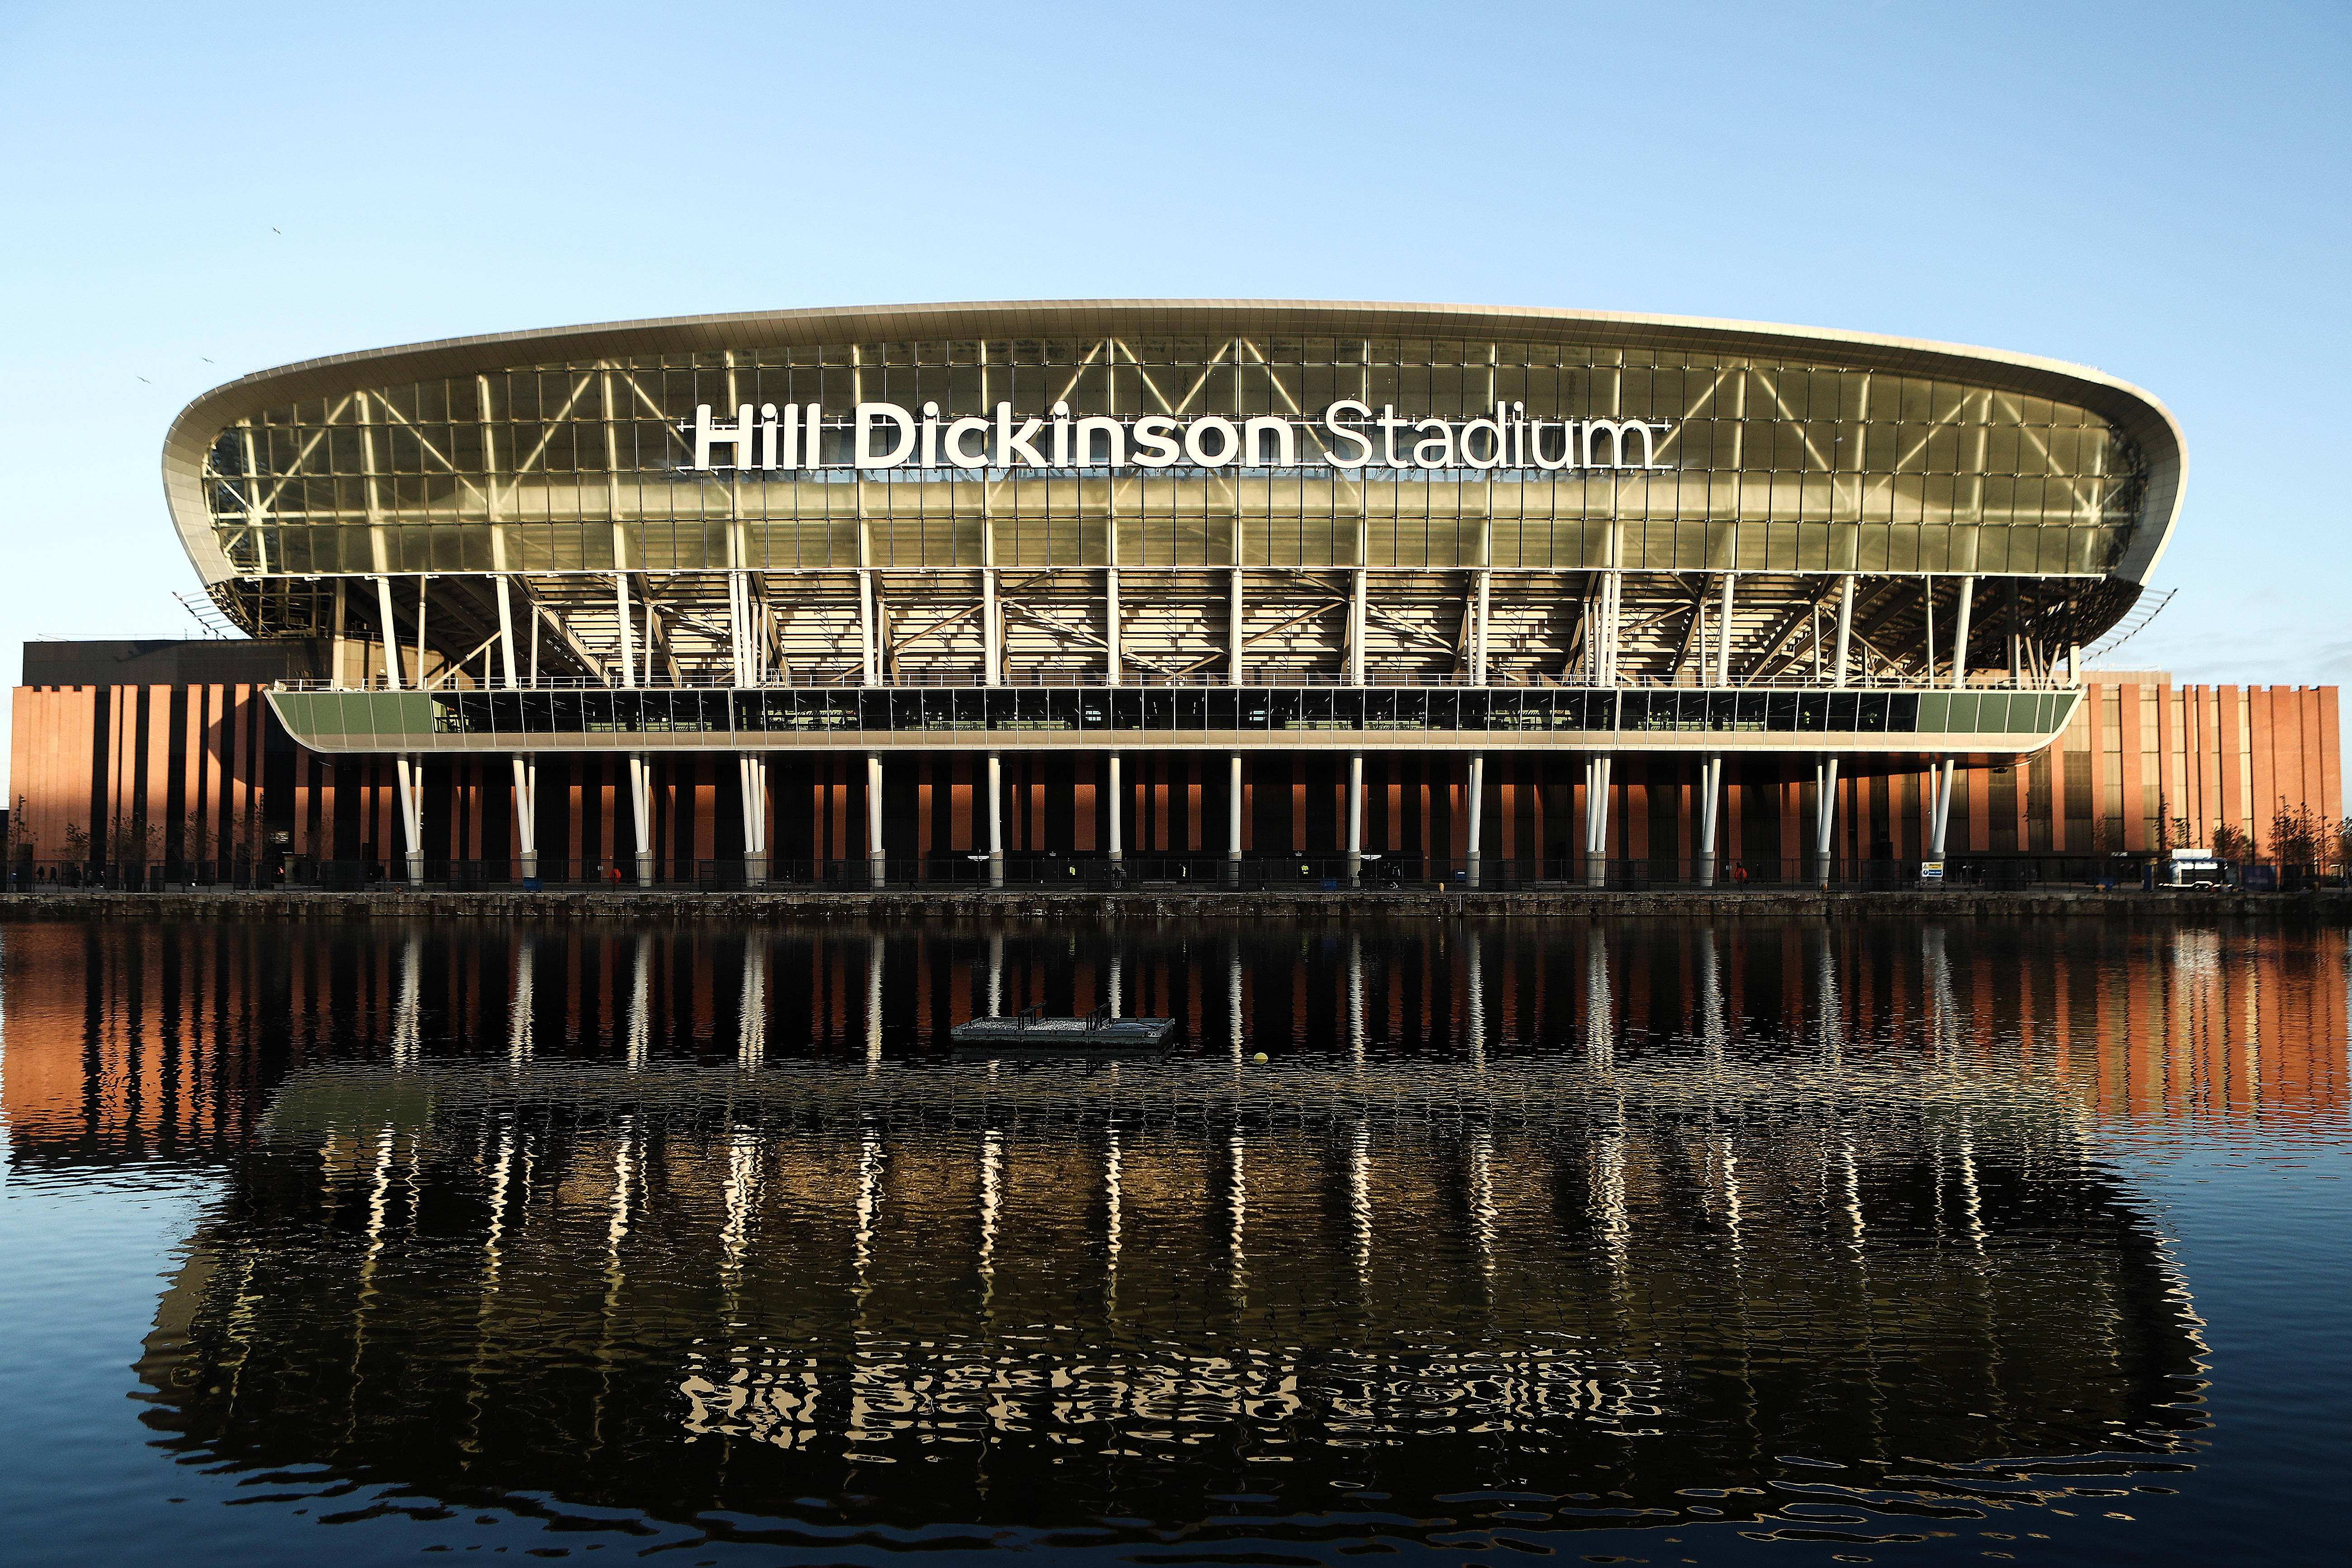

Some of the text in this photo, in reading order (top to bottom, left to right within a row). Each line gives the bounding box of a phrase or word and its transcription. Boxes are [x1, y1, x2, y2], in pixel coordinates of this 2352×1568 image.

[695, 399, 1653, 470] Hill Dickinson Stadium
